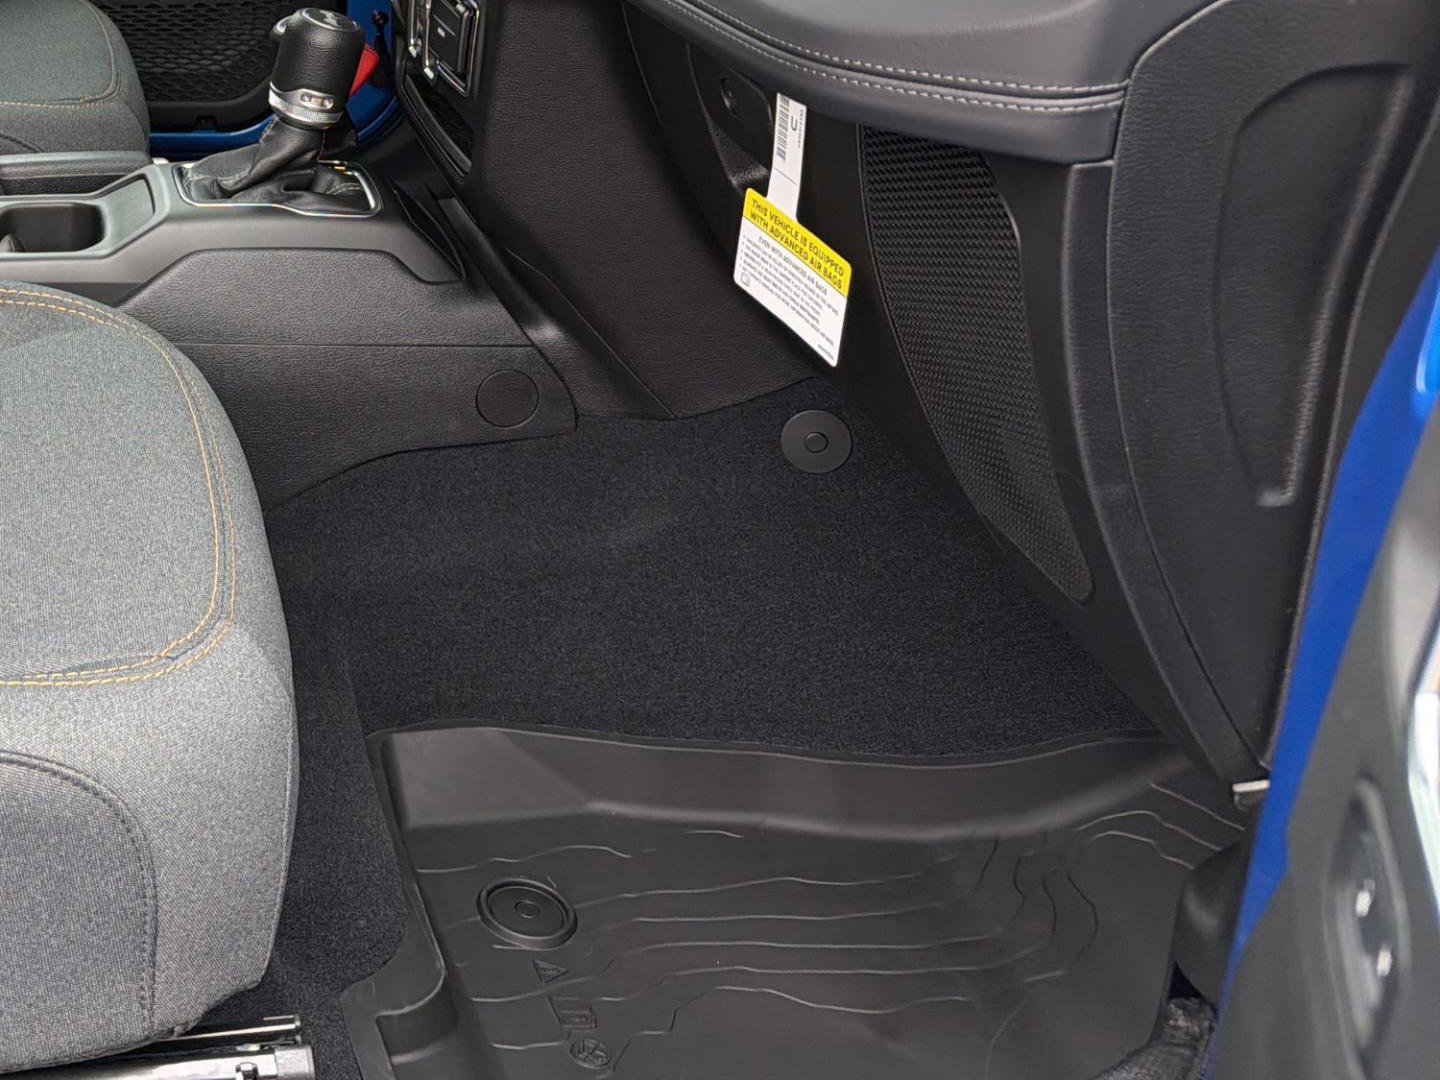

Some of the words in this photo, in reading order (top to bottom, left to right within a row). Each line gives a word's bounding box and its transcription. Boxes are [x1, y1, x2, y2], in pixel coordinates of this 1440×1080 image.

[749, 208, 769, 231] WITH
[769, 223, 809, 262] ADVANCED
[809, 255, 822, 273] AIR
[823, 266, 842, 290] BAGS
[751, 197, 768, 217] THIS
[768, 210, 799, 241] VEHICLE
[799, 234, 808, 248] IS
[808, 241, 845, 278] EQUIPPED
